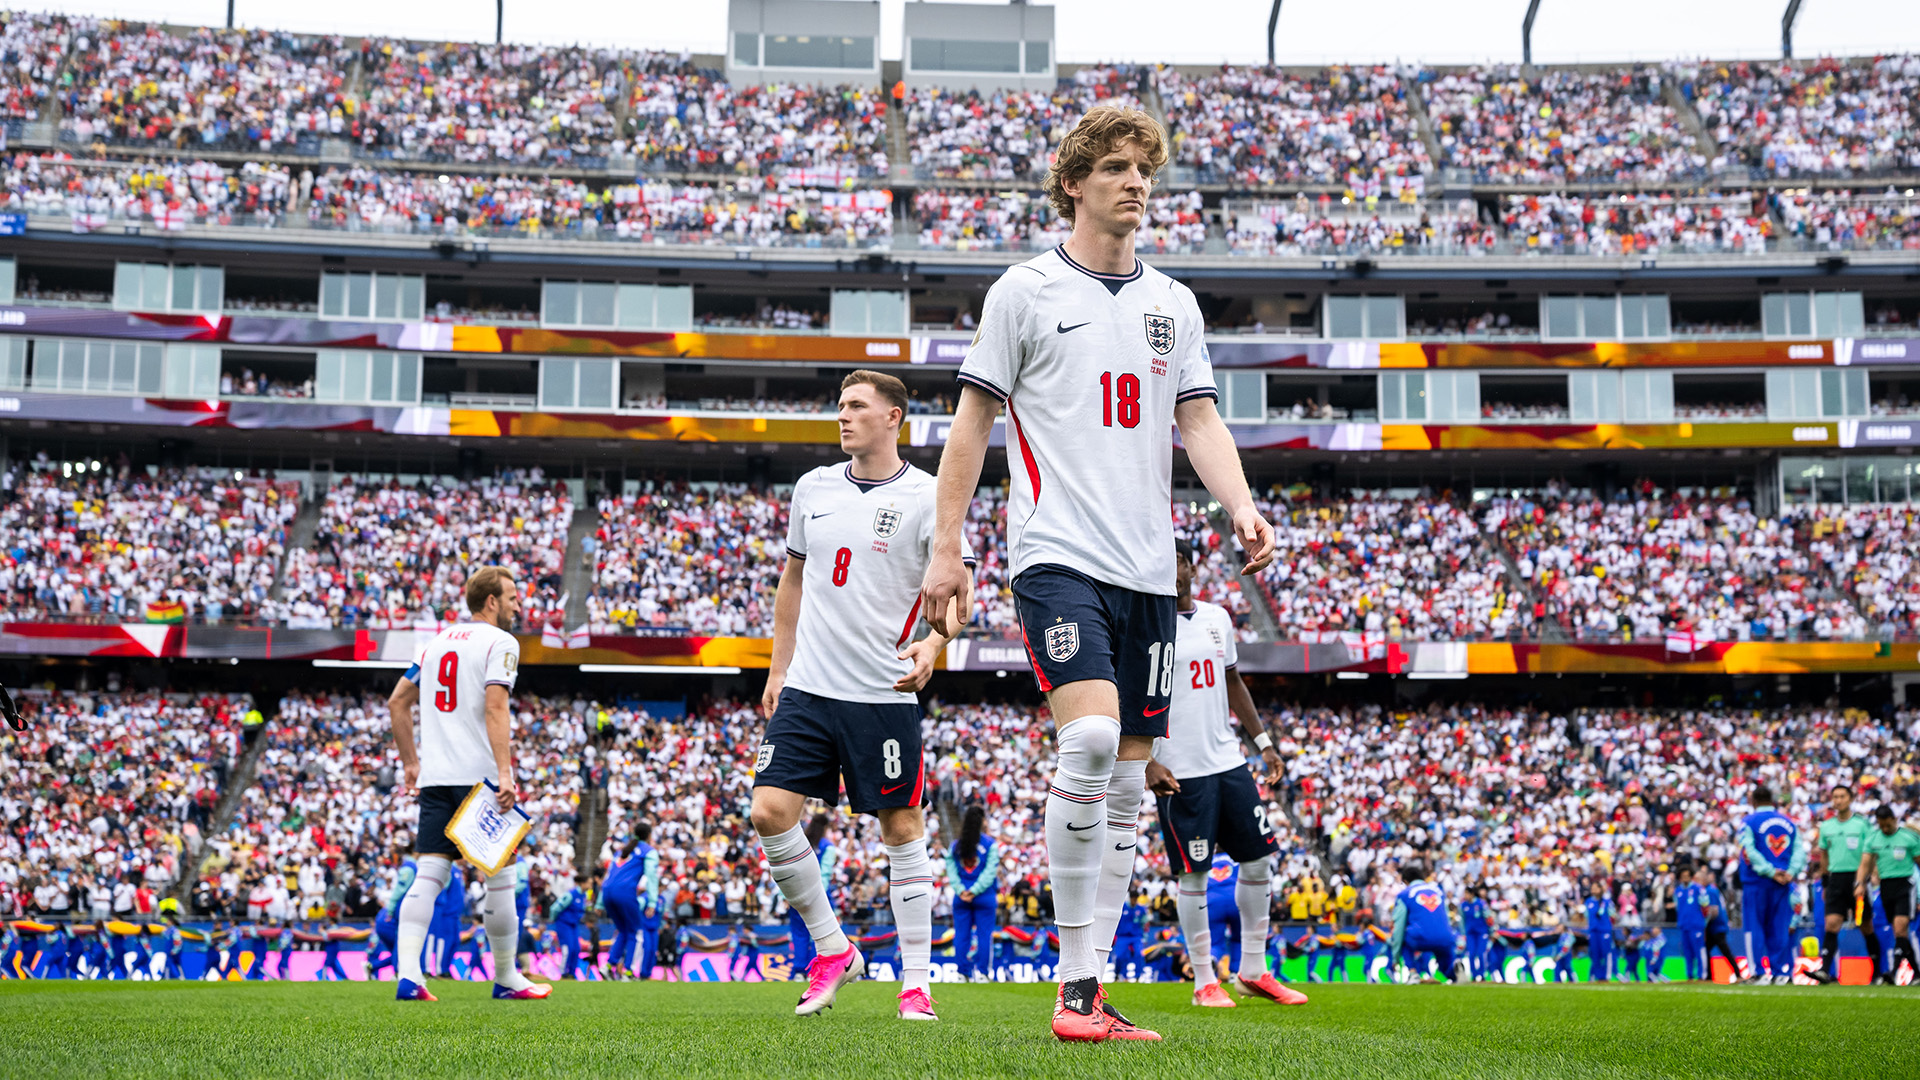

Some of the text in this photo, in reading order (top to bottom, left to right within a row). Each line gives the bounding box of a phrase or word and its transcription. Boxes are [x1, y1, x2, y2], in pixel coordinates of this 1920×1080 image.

[937, 344, 971, 358] ENGLA
[1151, 357, 1168, 368] GHANA
[1861, 343, 1906, 358] ENGLAND
[1100, 370, 1141, 429] 18
[1866, 425, 1911, 440] ENGLAND
[832, 546, 852, 587] 8
[434, 651, 459, 713] 9
[1147, 641, 1174, 697] 18
[1189, 658, 1215, 690] 20
[882, 738, 902, 779] 8
[1253, 804, 1272, 836] 2
